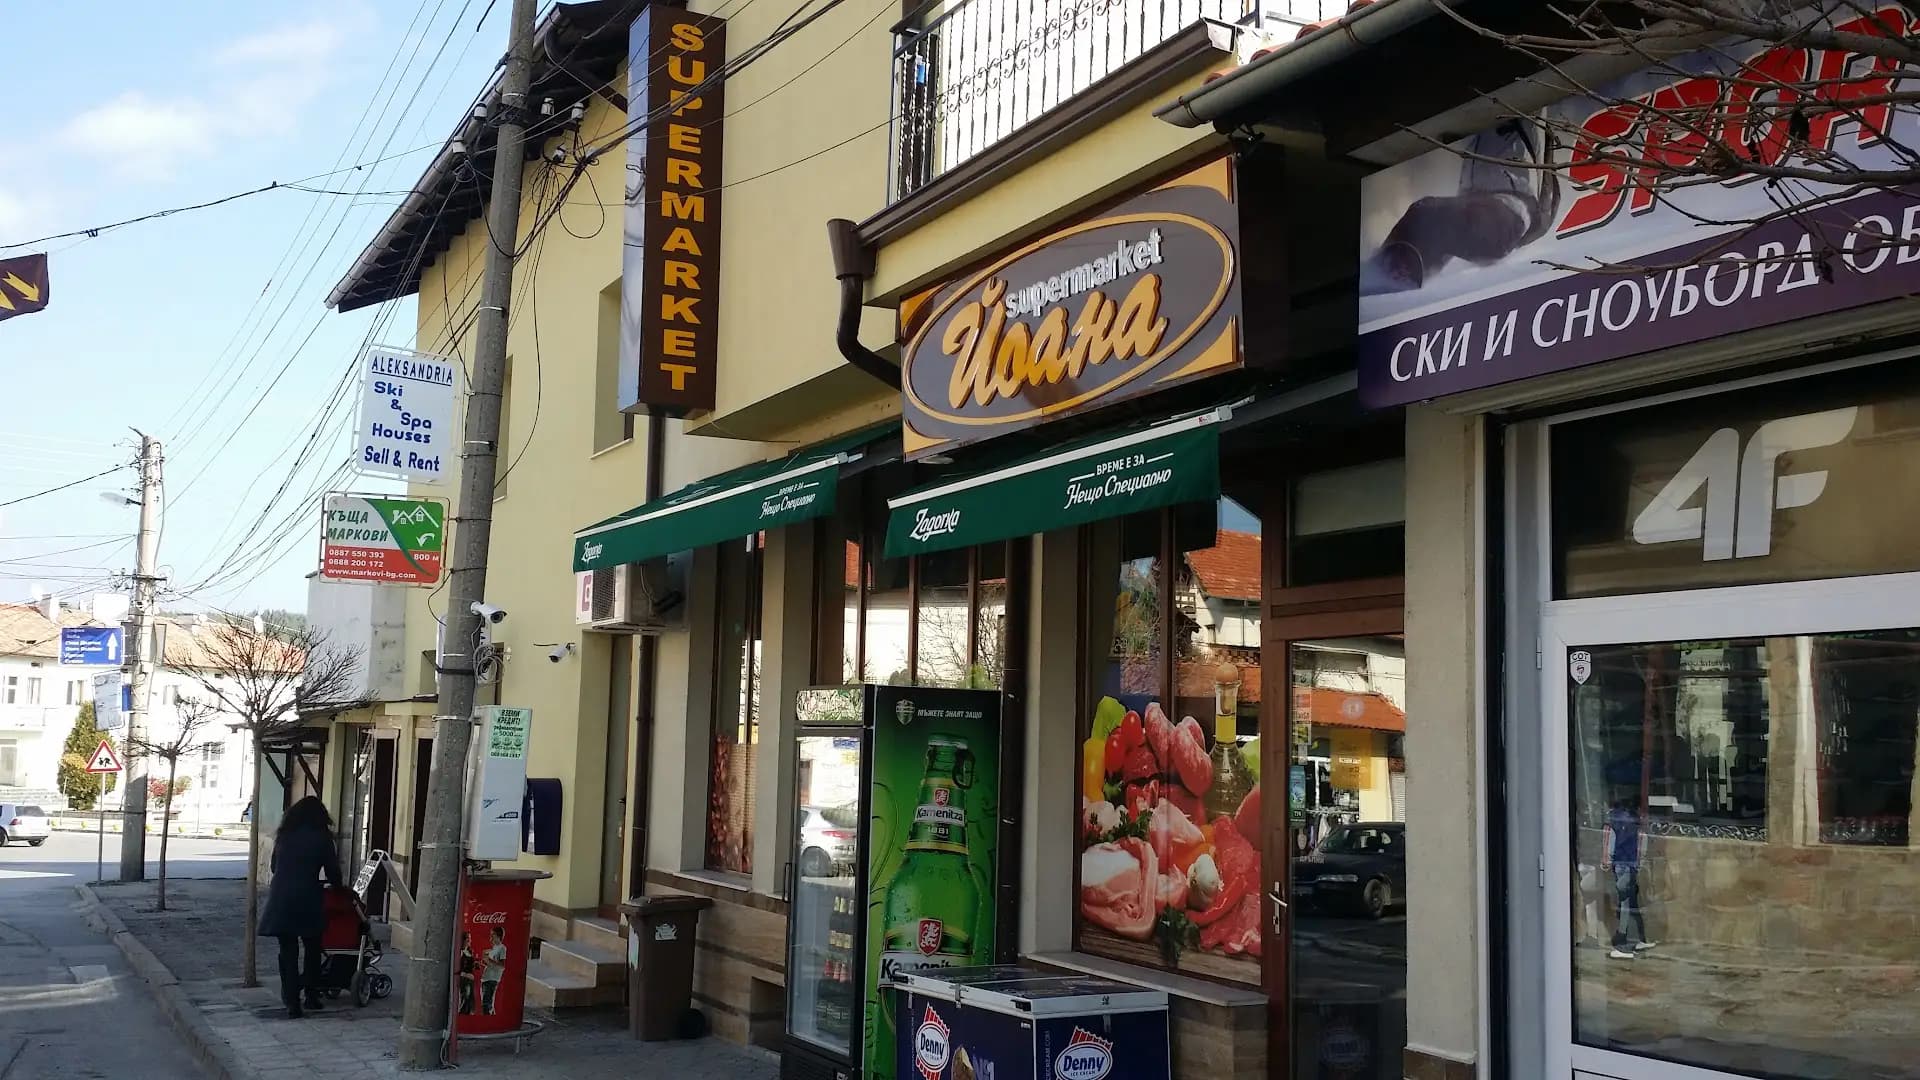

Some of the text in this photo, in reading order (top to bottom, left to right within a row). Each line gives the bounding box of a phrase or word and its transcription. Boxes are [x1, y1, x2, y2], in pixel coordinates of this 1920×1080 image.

[1556, 4, 1920, 240] SPOR
[660, 23, 705, 391] SUPERMARKET
[1005, 227, 1164, 318] supermarket
[1389, 321, 1473, 382] СКИ
[1482, 310, 1519, 361] И
[1532, 234, 1819, 348] СНОУБОРД
[942, 274, 1169, 409] Йоана
[371, 355, 453, 384] ALEKSANDRIA
[374, 381, 403, 396] Ski
[390, 398, 402, 411] &
[400, 412, 432, 431] Spa
[372, 422, 431, 444] Houses
[364, 445, 440, 471] Sell & Rent
[1096, 454, 1145, 476] ВРЕМЕ Е ЗА
[1064, 469, 1172, 509] Нещо Специално
[1632, 406, 1858, 561] 4F
[328, 509, 369, 524] КЪЩА
[910, 508, 960, 542] Zagorka
[327, 527, 389, 542] МАРКОВИ
[328, 558, 384, 568] 0888 200 172
[329, 548, 385, 559] 0887 550 393
[413, 553, 430, 561] 800
[327, 568, 416, 579] www.markovi-bg.com
[917, 808, 963, 821] Kamenitza
[920, 1032, 945, 1060] Denny
[1063, 1055, 1105, 1072] Denny
